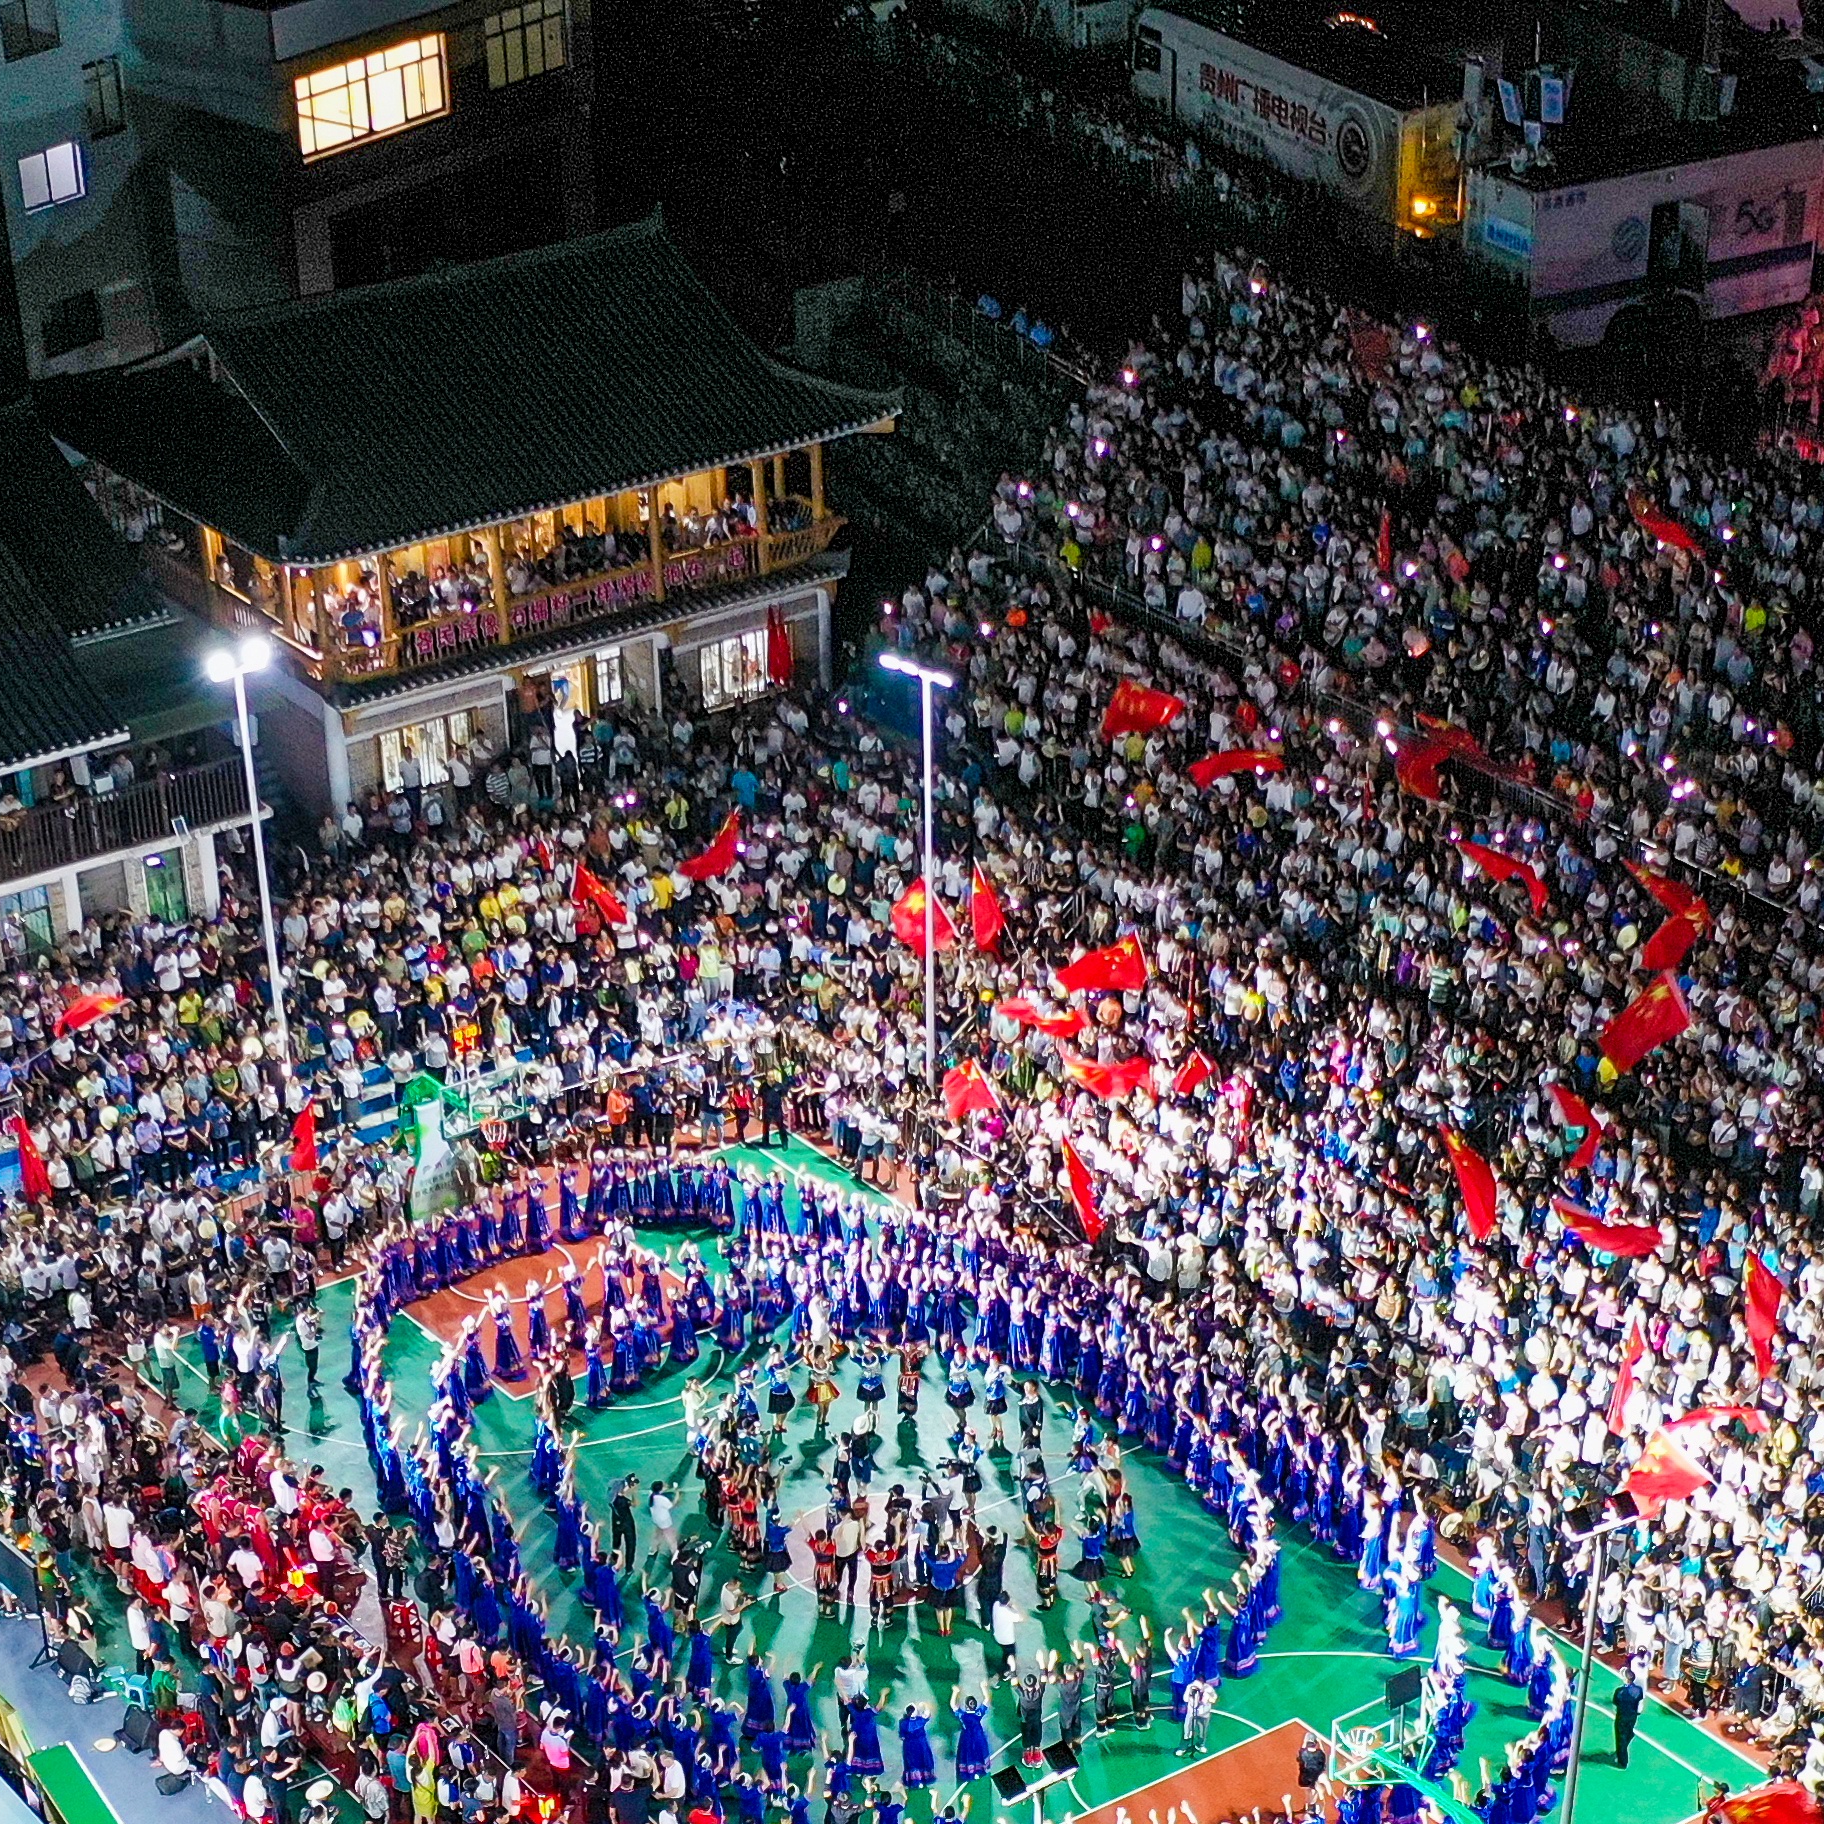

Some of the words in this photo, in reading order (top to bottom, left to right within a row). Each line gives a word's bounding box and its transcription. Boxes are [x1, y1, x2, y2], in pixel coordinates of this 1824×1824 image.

[1200, 62, 1326, 145] 贵州广播电视台
